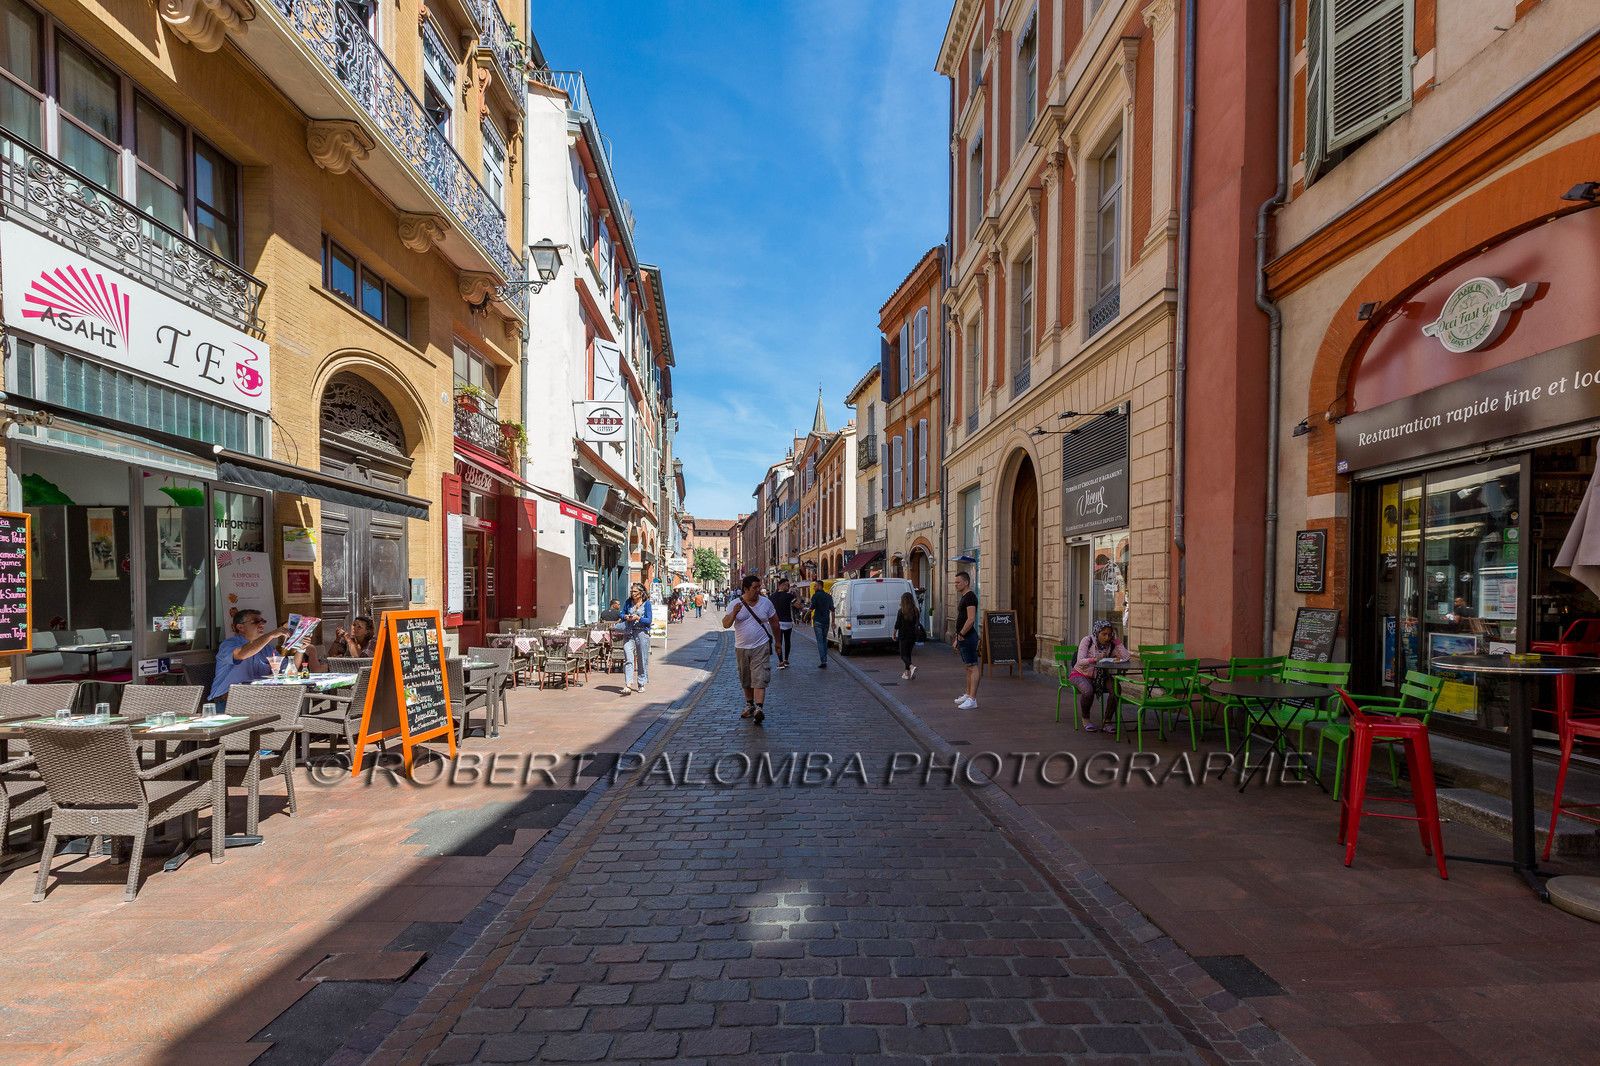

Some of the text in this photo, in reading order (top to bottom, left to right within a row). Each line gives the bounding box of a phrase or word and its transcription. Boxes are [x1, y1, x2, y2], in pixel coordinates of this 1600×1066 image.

[40, 306, 117, 348] ASAHI
[1439, 292, 1509, 333] Occi Fast Good
[1358, 415, 1441, 447] Restauration
[1446, 396, 1499, 423] rapide
[1504, 386, 1541, 412] fine
[1548, 377, 1567, 396] et
[1076, 486, 1108, 517] Vicens
